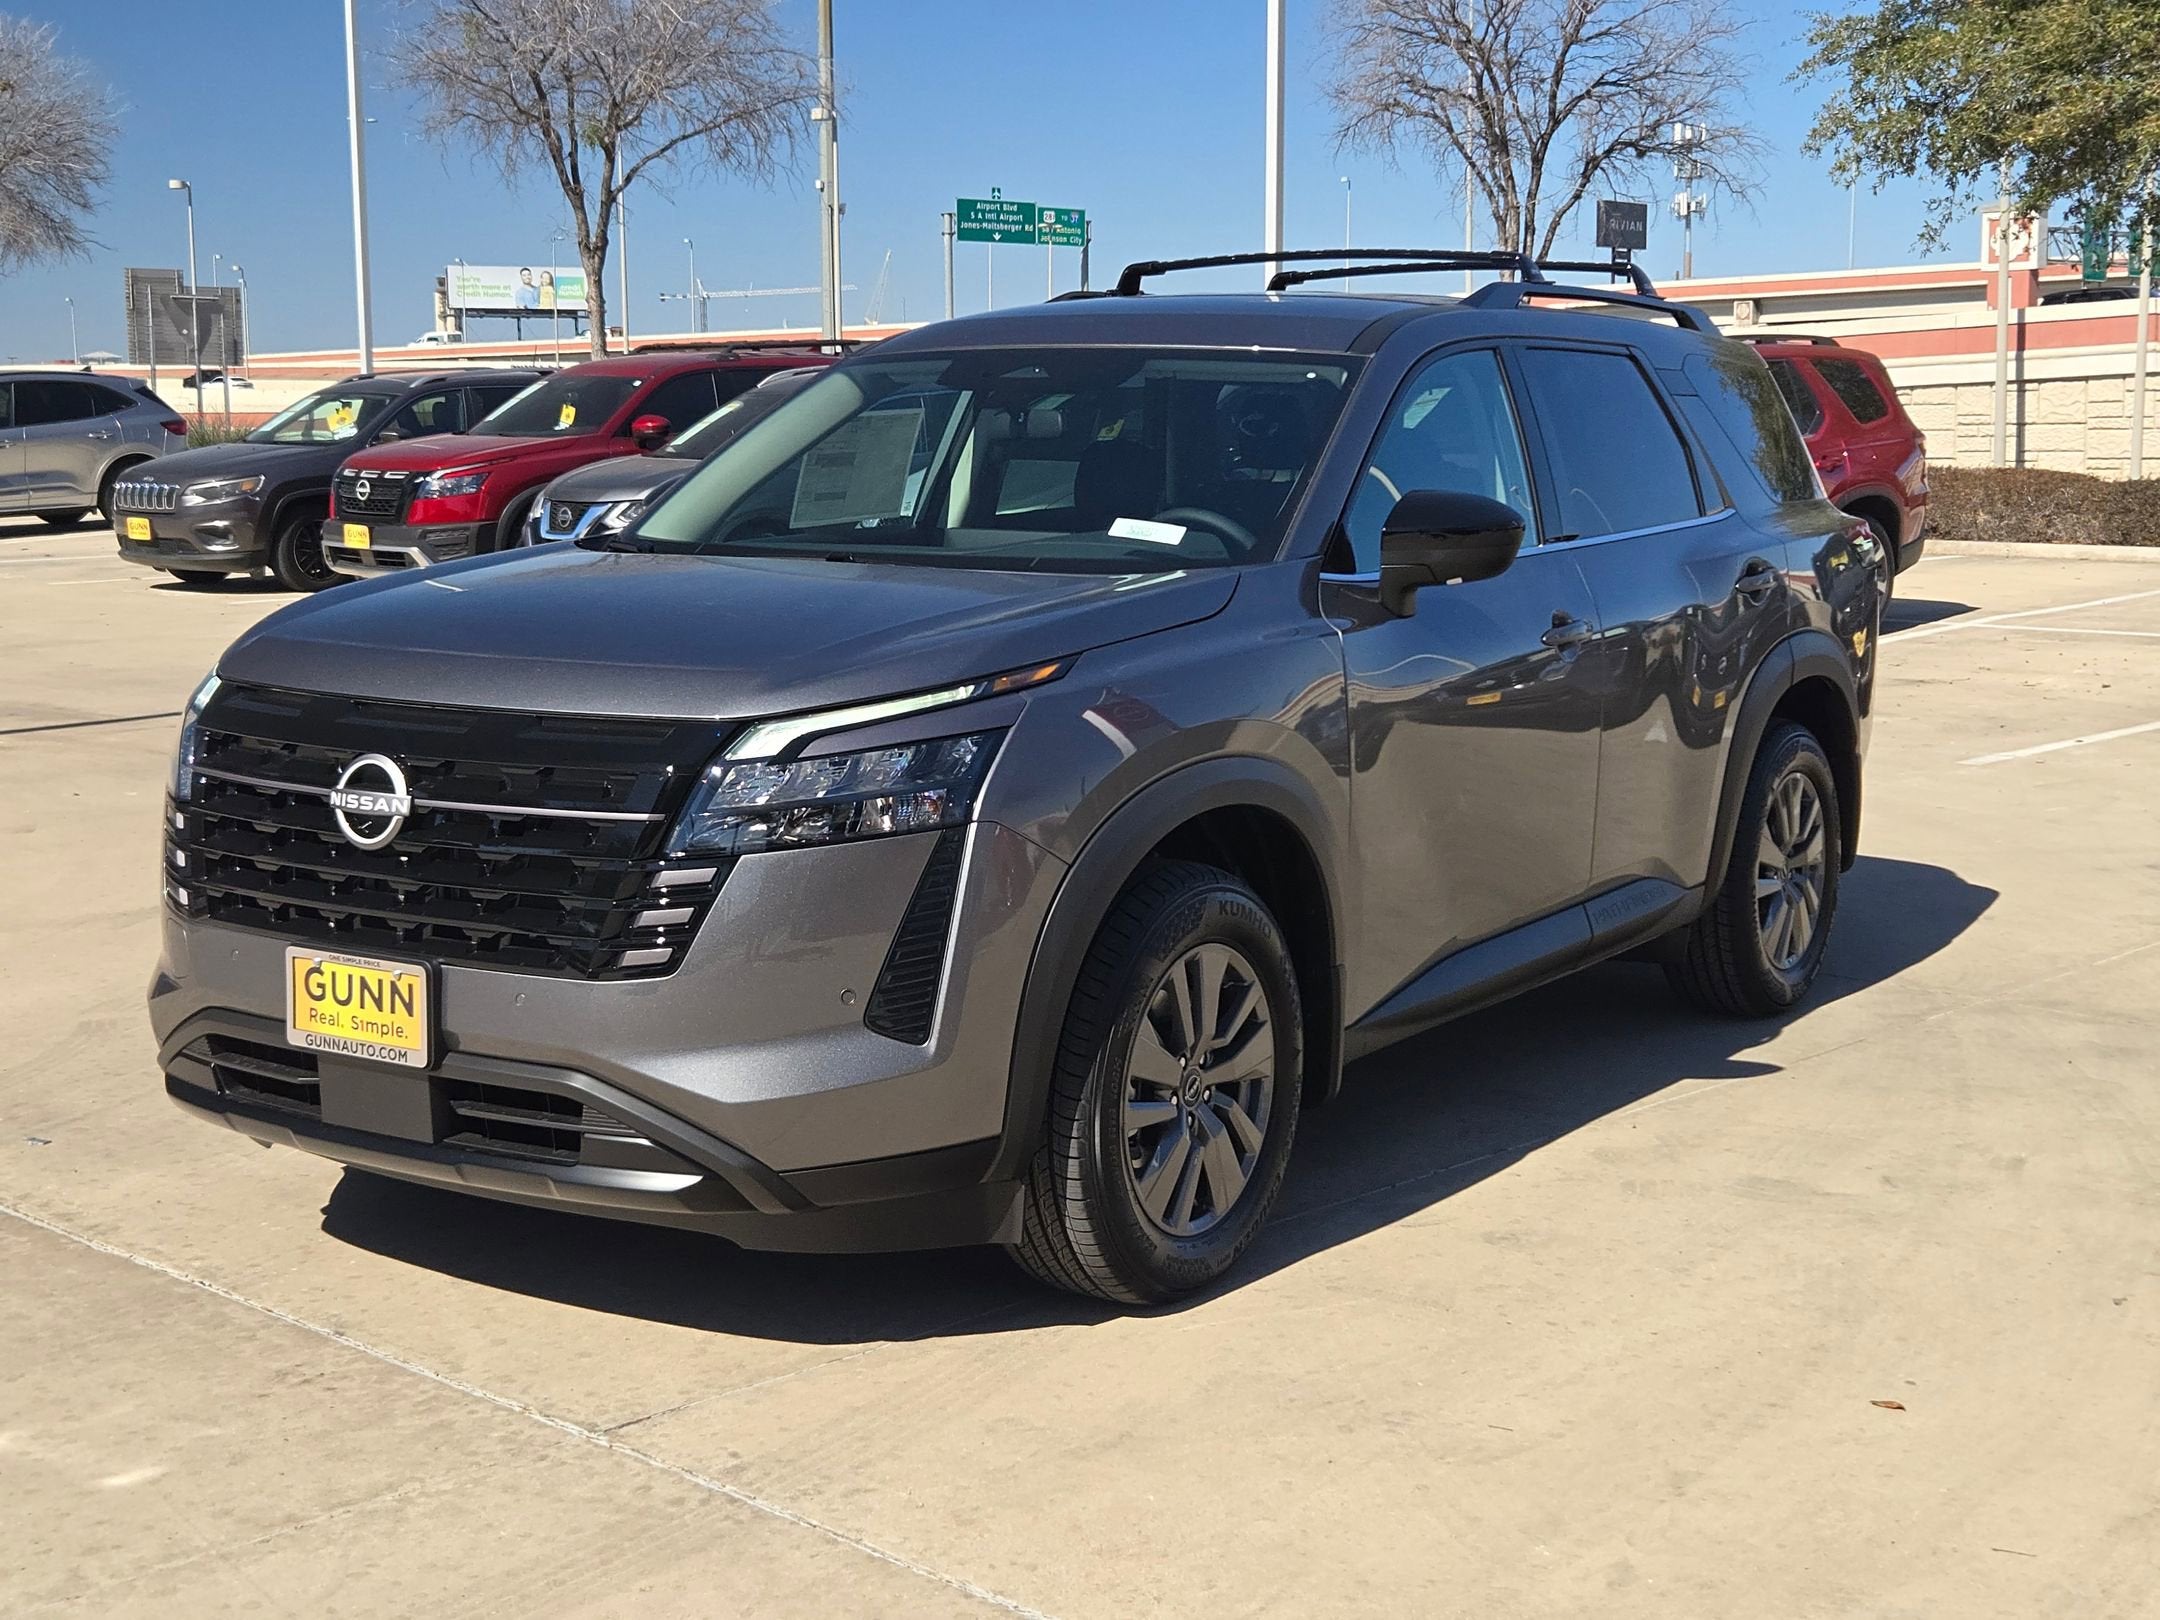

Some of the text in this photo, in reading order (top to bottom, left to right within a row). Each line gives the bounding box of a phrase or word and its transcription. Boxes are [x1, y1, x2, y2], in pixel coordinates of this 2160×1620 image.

[976, 202, 1018, 212] Airport Blvd
[970, 211, 1023, 223] S A Intl Airport
[1609, 218, 1643, 232] RIVIAN
[960, 221, 1034, 233] Jones-Maltsberger Rd
[1069, 236, 1082, 246] City
[330, 790, 408, 814] NISSAN
[1218, 900, 1272, 940] KUMHO
[304, 966, 414, 1018] GUNN
[309, 1007, 344, 1029] Real.
[305, 1033, 408, 1063] GUNNAUTO.COM
